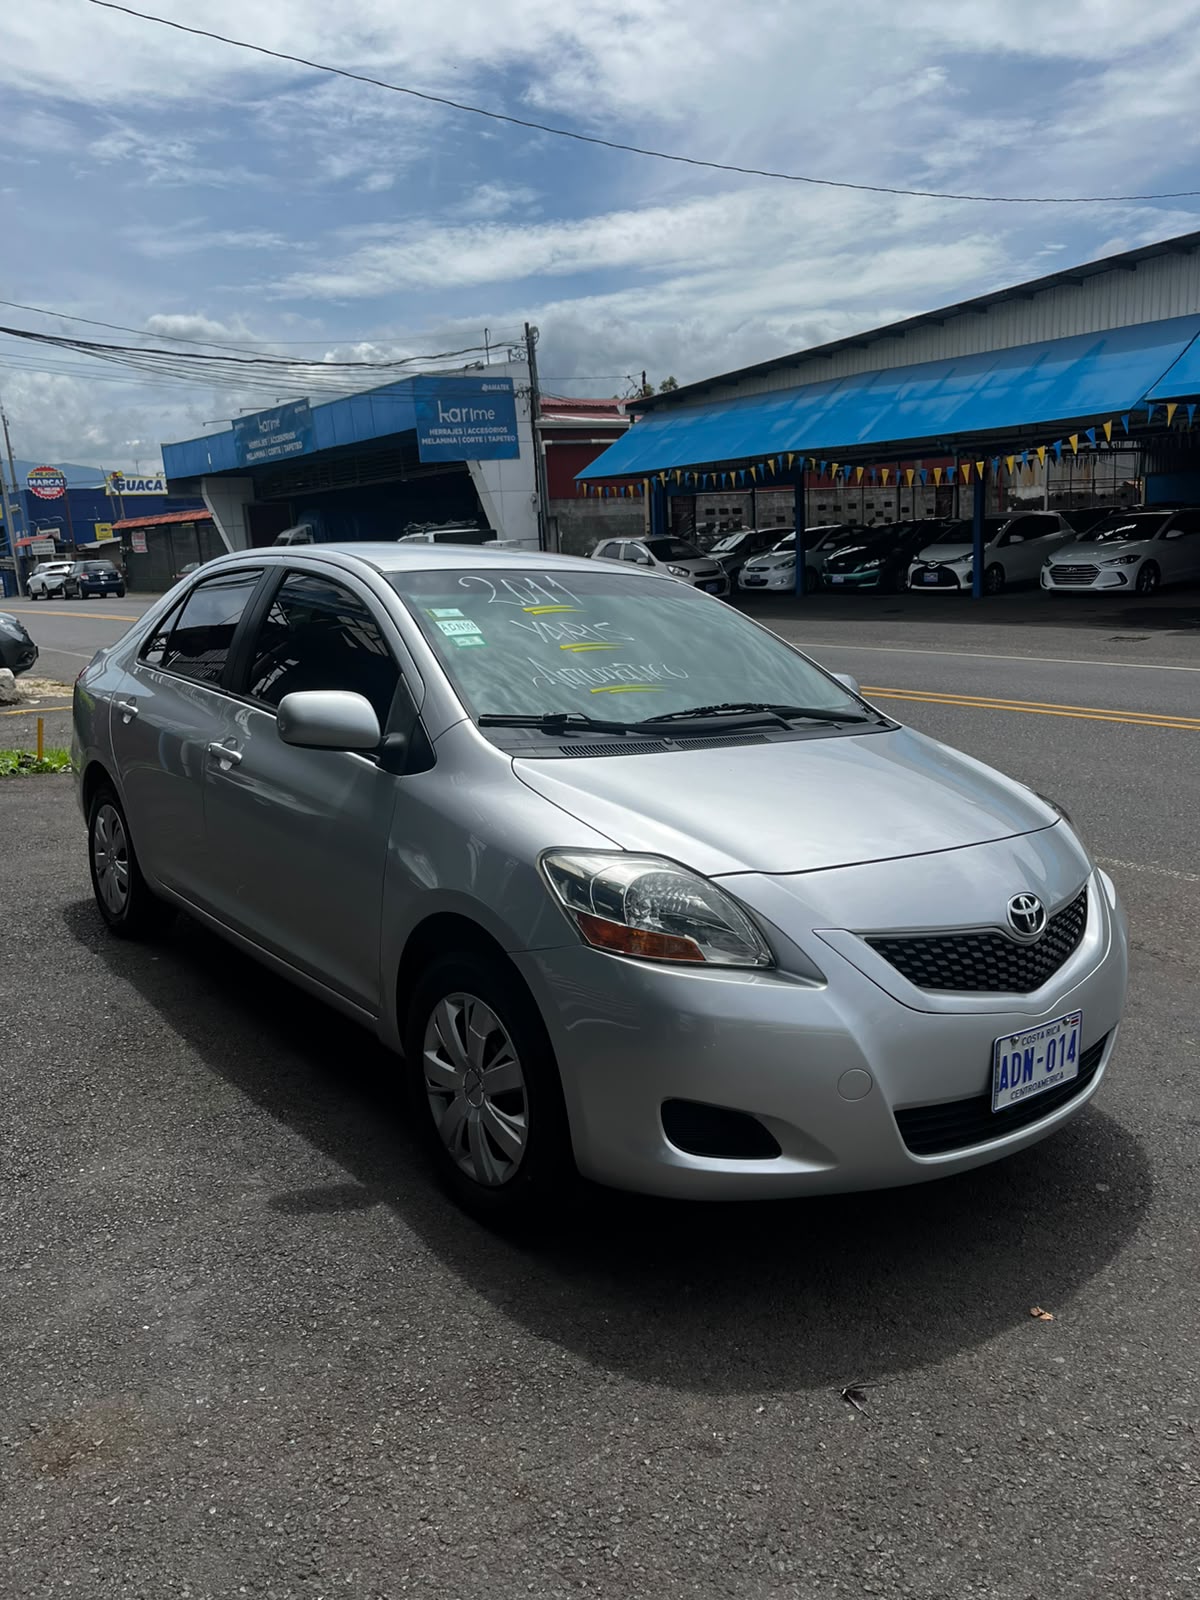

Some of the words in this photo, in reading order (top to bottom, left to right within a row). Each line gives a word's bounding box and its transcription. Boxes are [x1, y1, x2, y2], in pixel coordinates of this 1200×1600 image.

[437, 400, 496, 424] karime
[421, 436, 458, 445] MELAMINA
[488, 435, 516, 443] TAPETEO
[429, 427, 463, 436] HERRAJES
[467, 426, 508, 435] ACCESORIOS
[458, 575, 584, 606] 2011
[509, 620, 636, 644] YARIS
[1021, 1031, 1045, 1047] COSTA
[1045, 1024, 1061, 1038] RICA
[999, 1029, 1078, 1092] ADN-014
[1011, 1072, 1064, 1099] CENTROAMERICA
